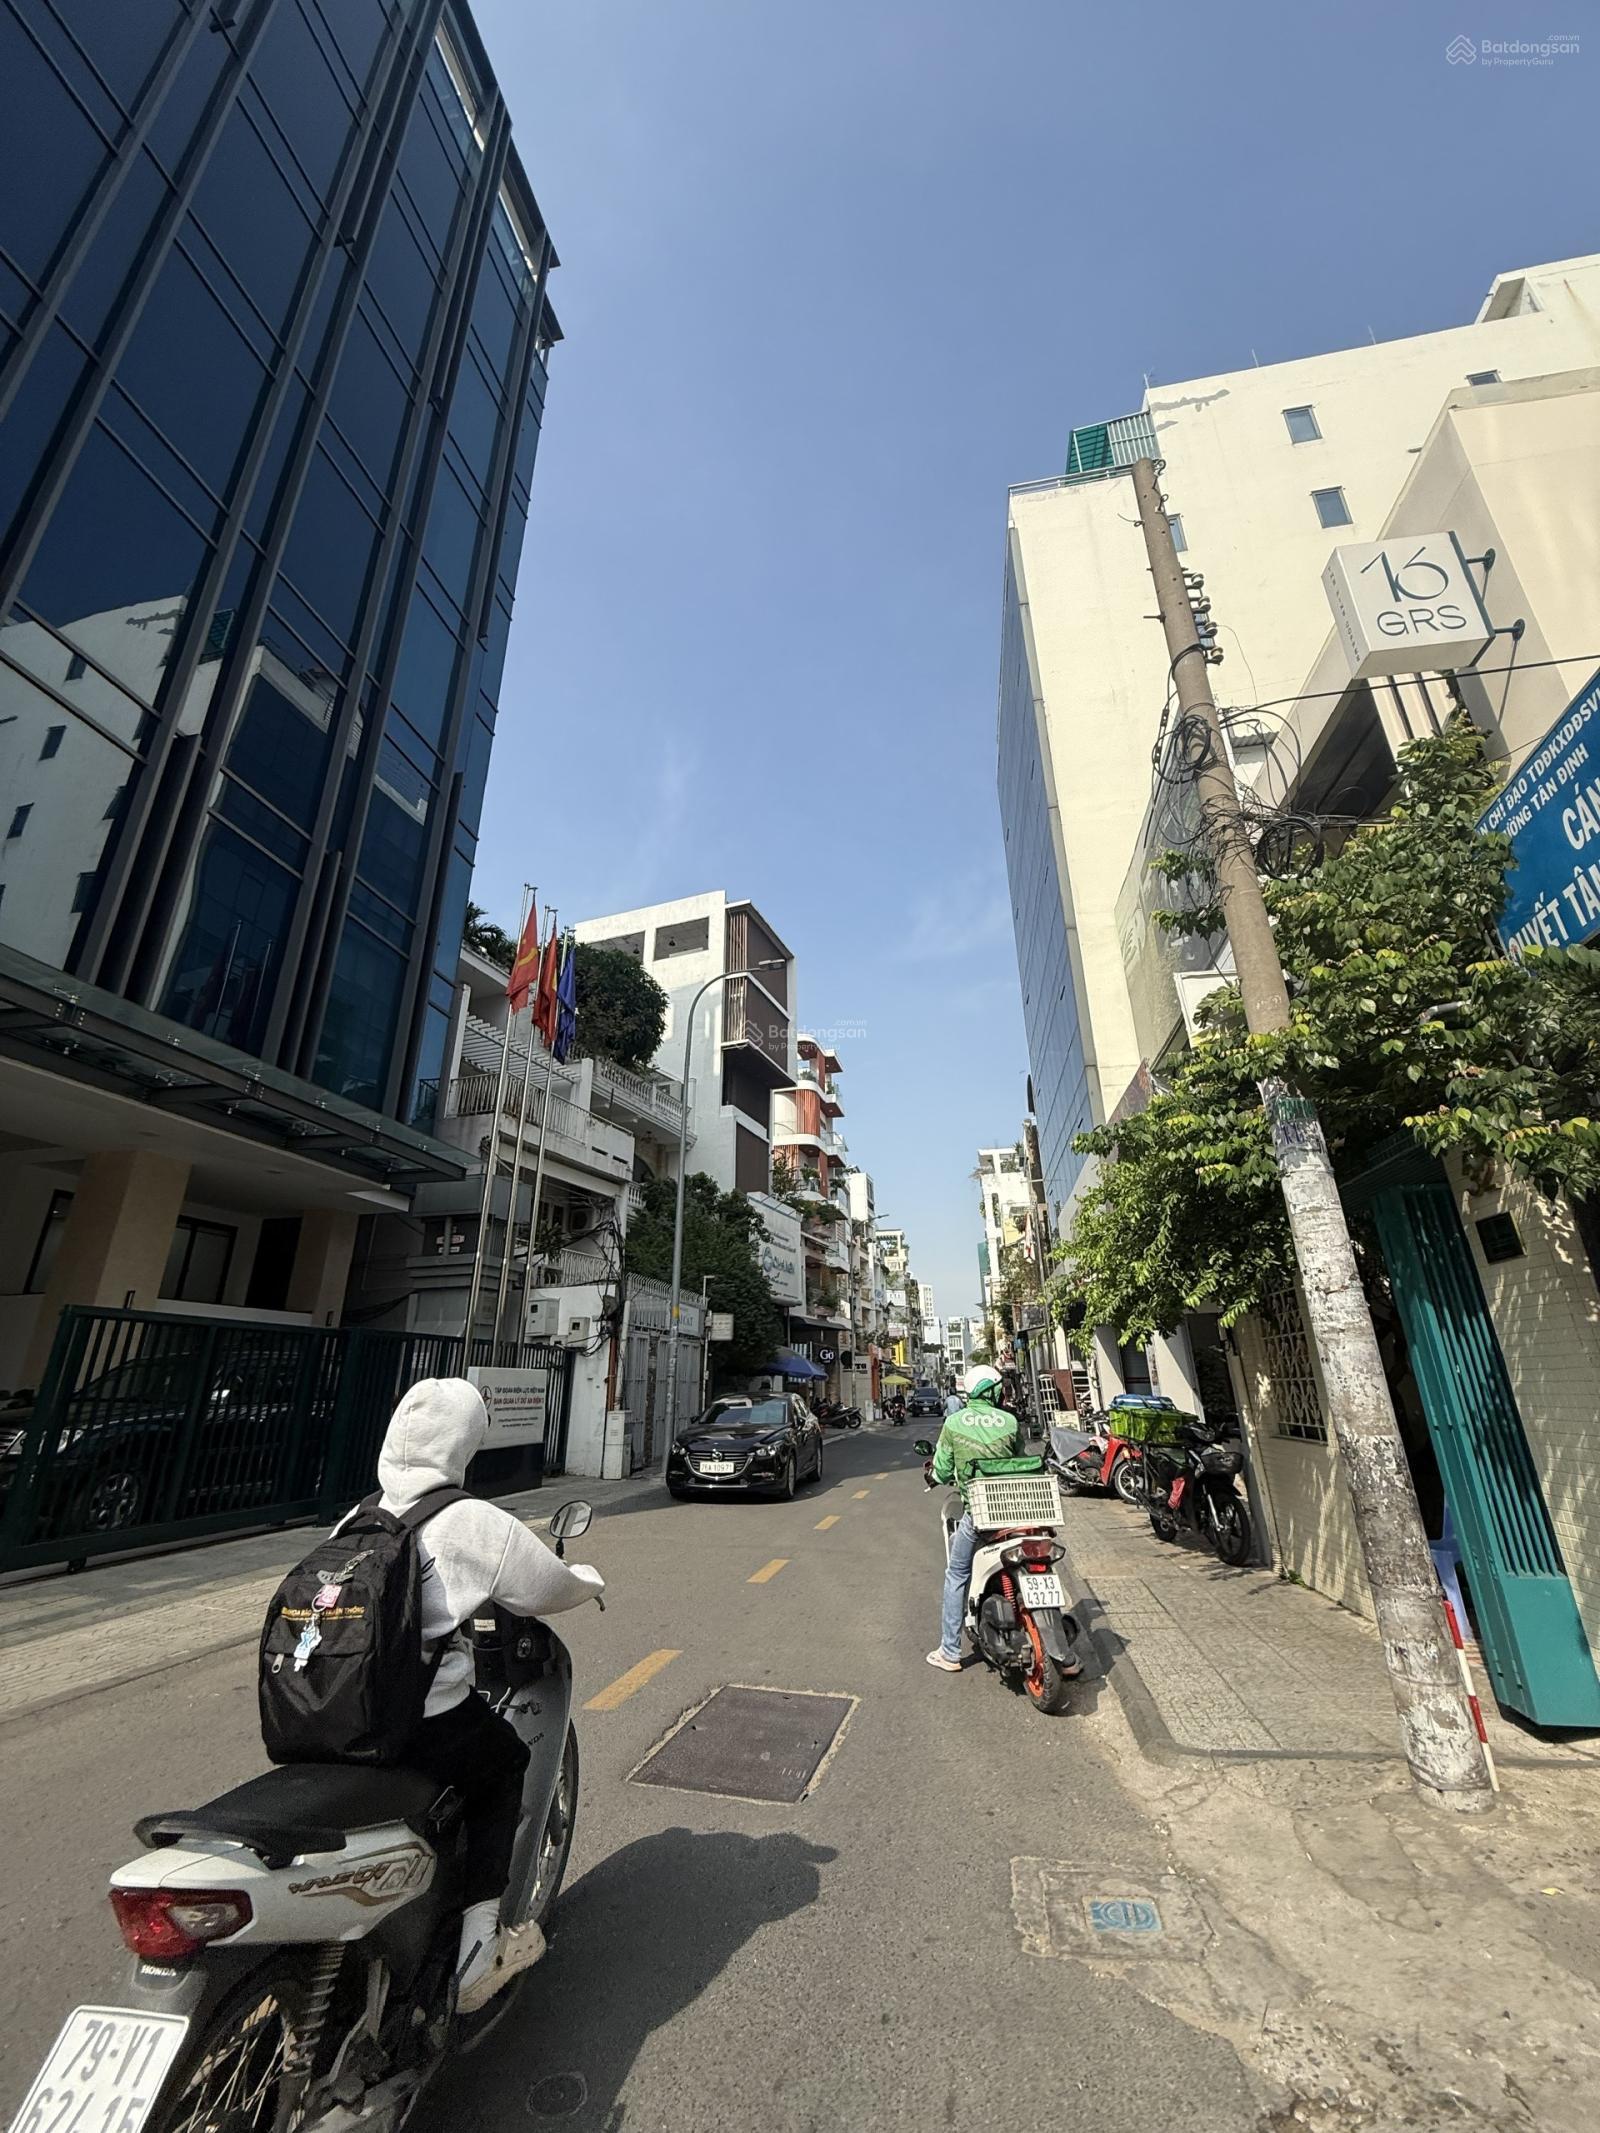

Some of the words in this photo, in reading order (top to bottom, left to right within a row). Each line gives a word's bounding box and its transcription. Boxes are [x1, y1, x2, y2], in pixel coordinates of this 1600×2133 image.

[1360, 546, 1449, 603] 16
[1377, 604, 1467, 637] GRS
[1530, 777, 1559, 812] TÂN
[1556, 742, 1590, 785] ĐỊNH
[961, 1411, 1005, 1427] Grab
[1026, 1577, 1055, 1591] 59-X3
[140, 1964, 177, 1977] HONDA
[61, 2019, 165, 2088] 79-V1
